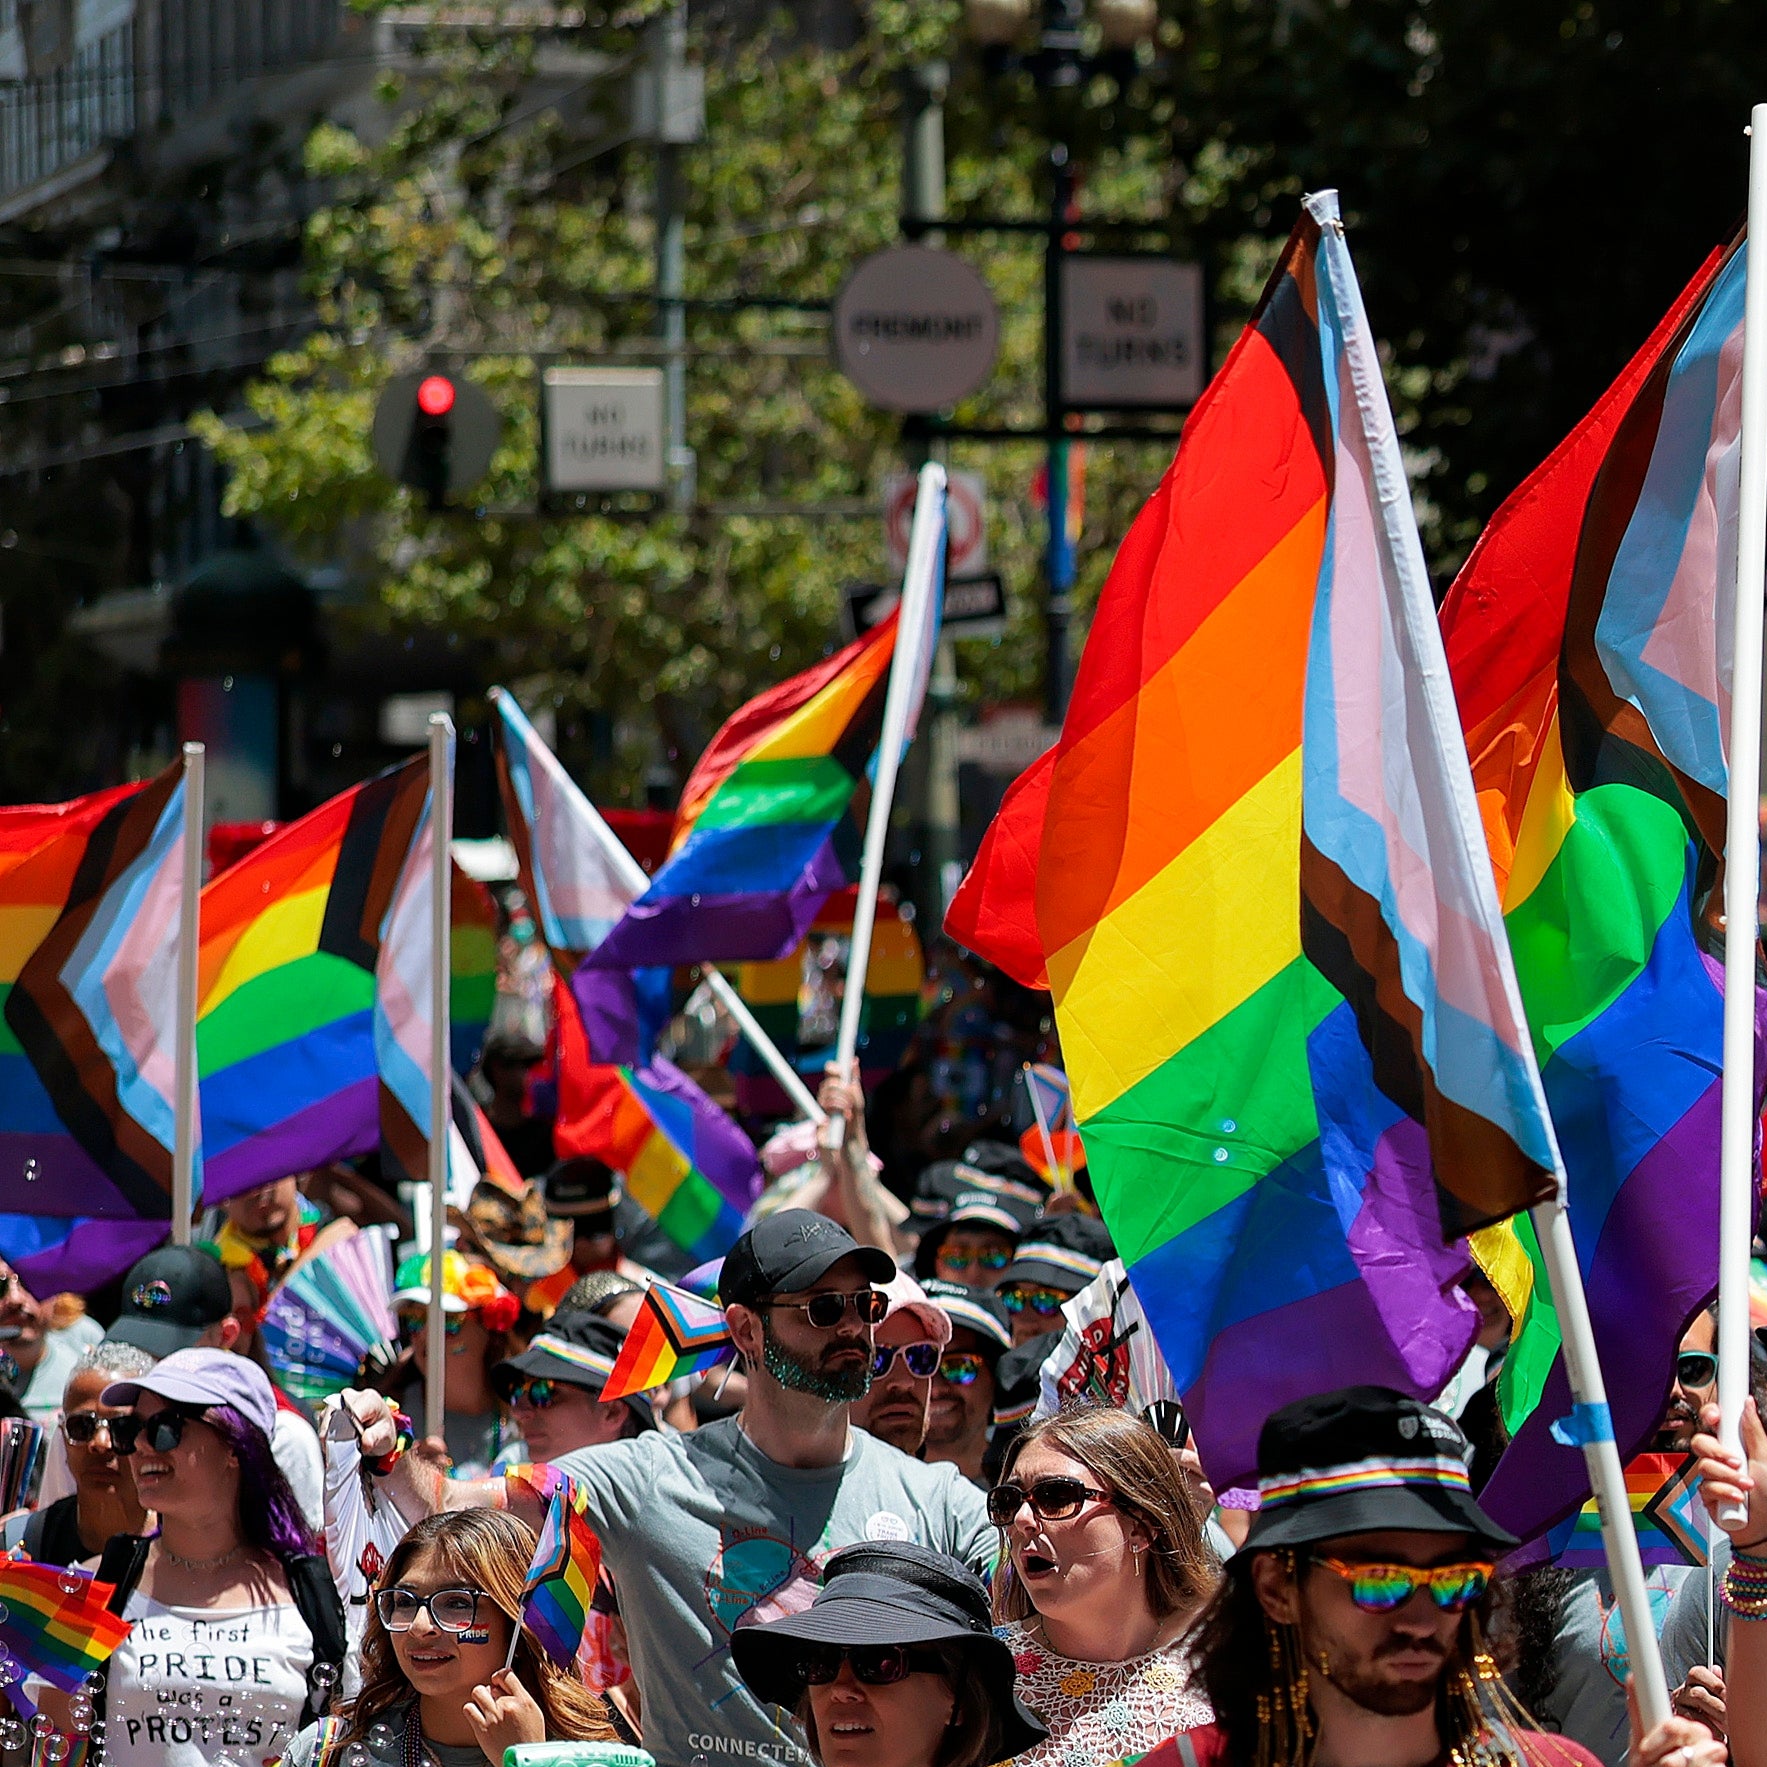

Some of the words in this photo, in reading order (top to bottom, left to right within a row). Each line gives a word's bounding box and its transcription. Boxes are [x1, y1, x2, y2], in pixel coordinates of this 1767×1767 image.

[732, 1526, 768, 1539] Q-Line
[189, 1619, 252, 1643] first
[458, 1629, 488, 1640] PRIDE
[138, 1652, 273, 1685] PRIDE
[156, 1690, 204, 1706] was
[219, 1694, 233, 1707] a
[127, 1712, 288, 1747] PROTEST
